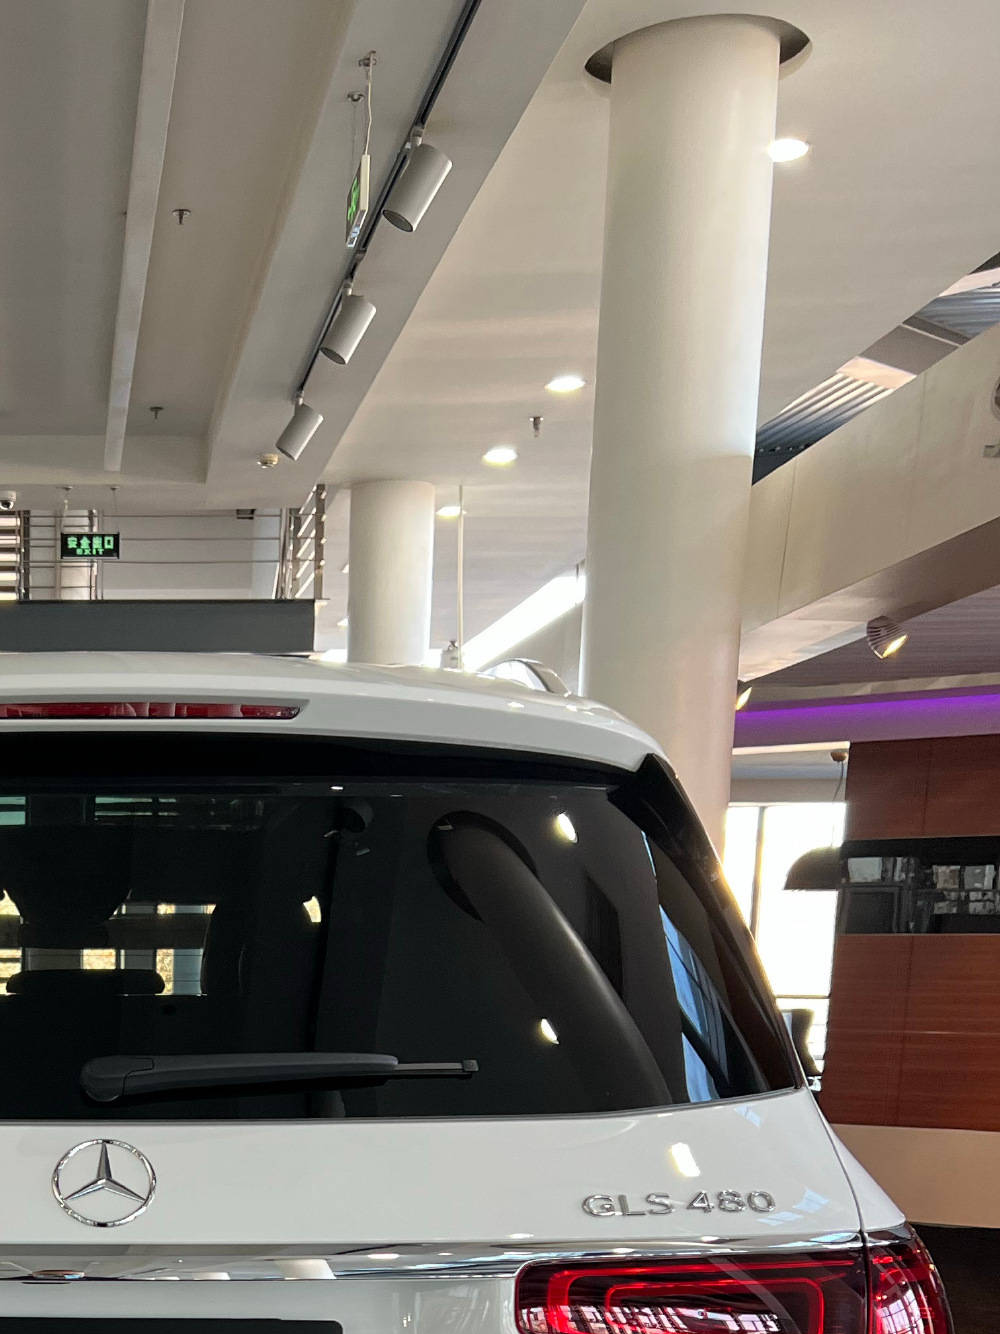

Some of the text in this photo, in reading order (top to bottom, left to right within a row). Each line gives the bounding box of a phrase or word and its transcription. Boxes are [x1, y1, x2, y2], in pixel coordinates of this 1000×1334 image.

[66, 536, 114, 549] 安全出口
[581, 1189, 776, 1217] GLS 480
